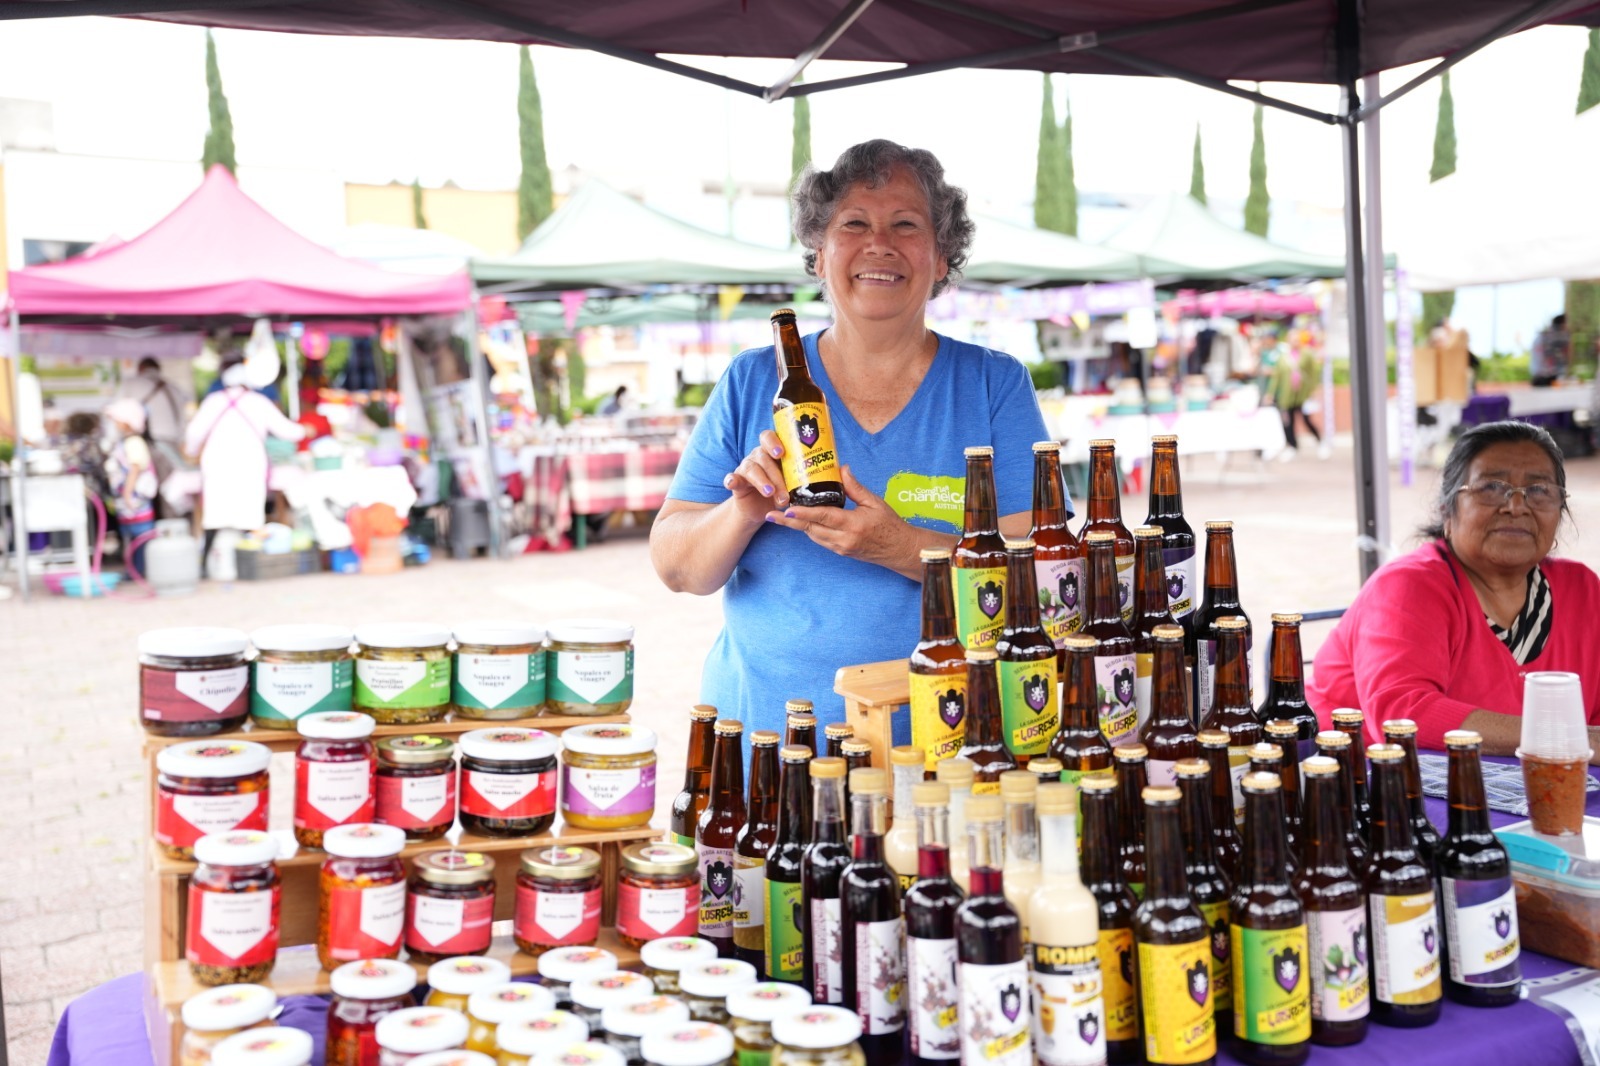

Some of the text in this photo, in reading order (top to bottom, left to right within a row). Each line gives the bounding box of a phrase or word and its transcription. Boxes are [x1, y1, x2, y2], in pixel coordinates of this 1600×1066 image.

[898, 490, 965, 504] ChannelCo
[700, 905, 733, 922] LOSREY
[1037, 944, 1098, 965] ROMP
